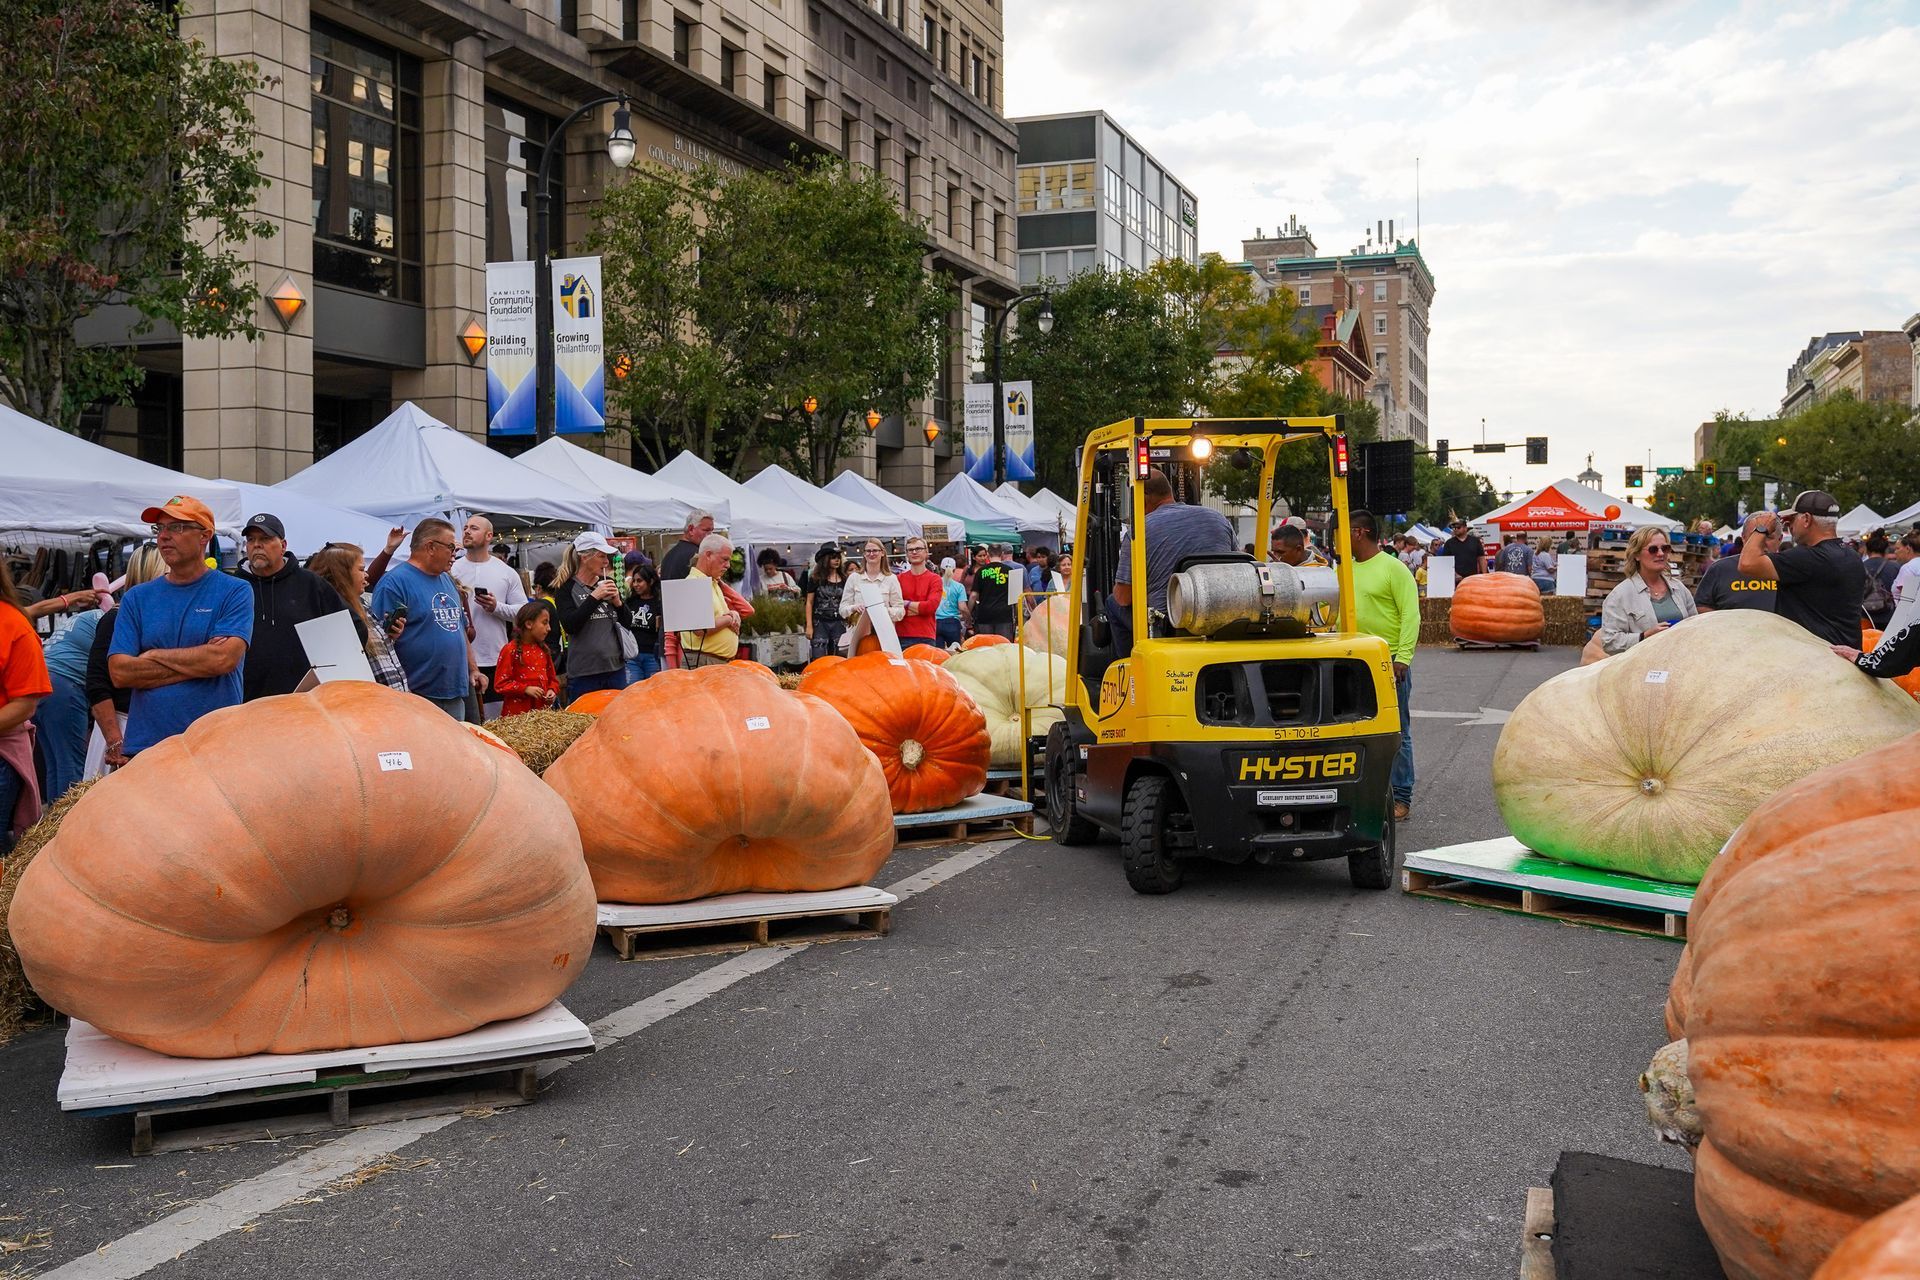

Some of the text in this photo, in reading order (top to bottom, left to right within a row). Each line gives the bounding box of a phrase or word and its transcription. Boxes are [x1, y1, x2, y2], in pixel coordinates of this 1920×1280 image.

[674, 134, 710, 164] BUTLER
[648, 144, 700, 172] GOVERNMEN
[489, 295, 534, 307] Community
[490, 305, 532, 315] Foundation
[489, 335, 526, 346] Building
[556, 332, 590, 343] Growing
[489, 346, 534, 357] Community
[556, 343, 602, 354] Philanthropy
[982, 567, 1001, 578] FRIDAY
[1731, 580, 1777, 591] CLONE
[433, 609, 460, 620] TEXAS
[1165, 670, 1194, 678] Schulhoff
[1170, 684, 1188, 692] Rental
[1101, 730, 1116, 738] HYSTER
[386, 758, 403, 766] 416
[1239, 752, 1357, 780] HYSTER
